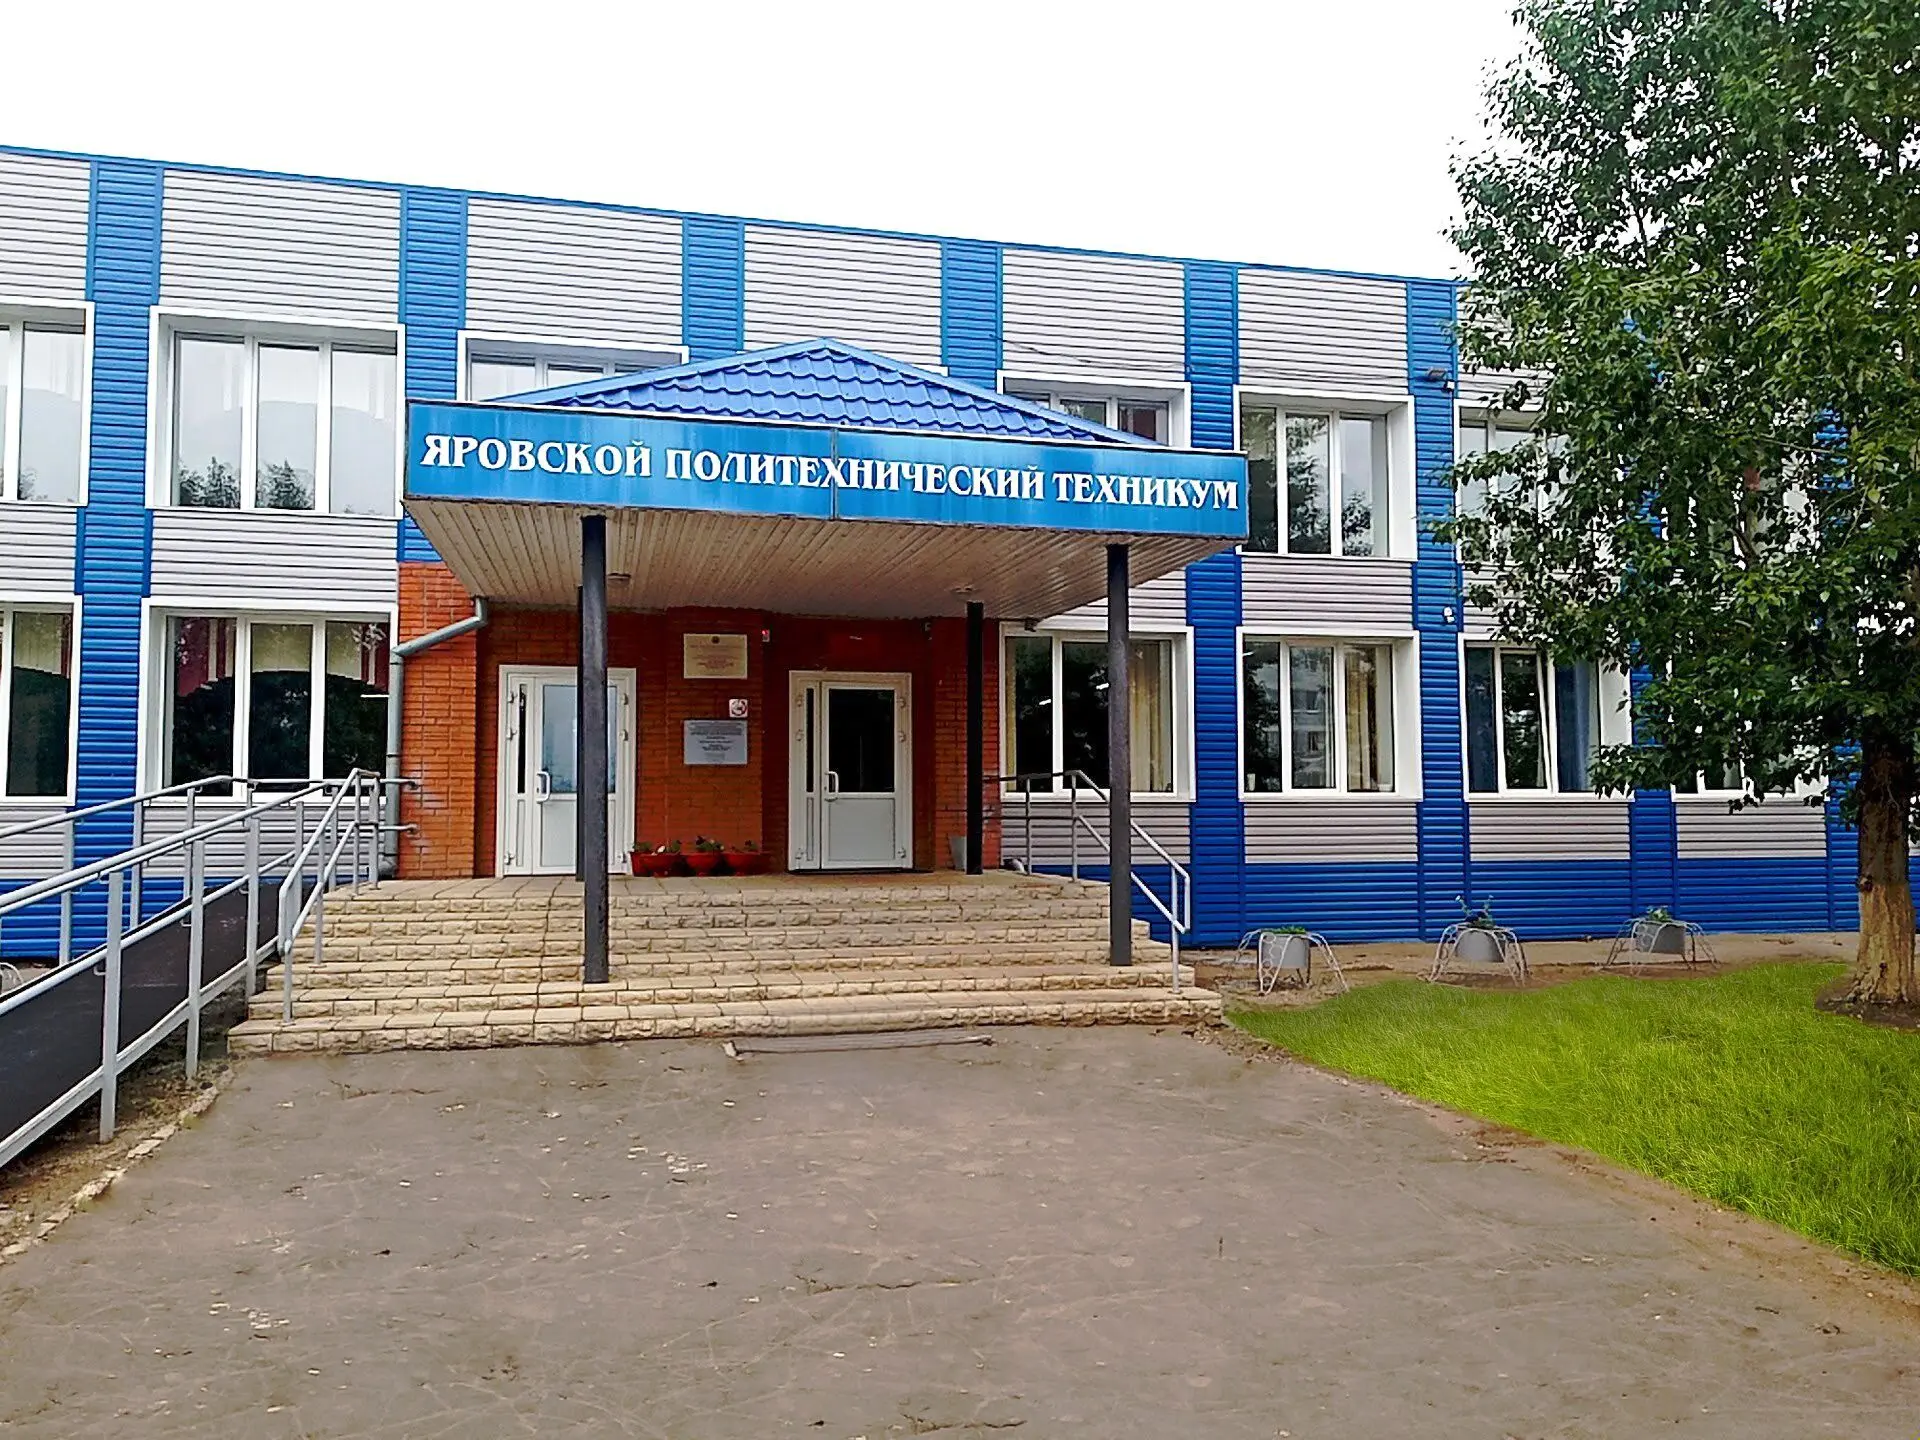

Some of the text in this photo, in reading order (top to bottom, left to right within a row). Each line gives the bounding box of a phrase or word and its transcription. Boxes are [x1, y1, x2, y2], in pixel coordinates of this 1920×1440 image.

[420, 434, 1239, 510] ЯРОВСКОЙ ПОЛИТЕХНИЧЕСКИЙ ТЕХНИКУМ
